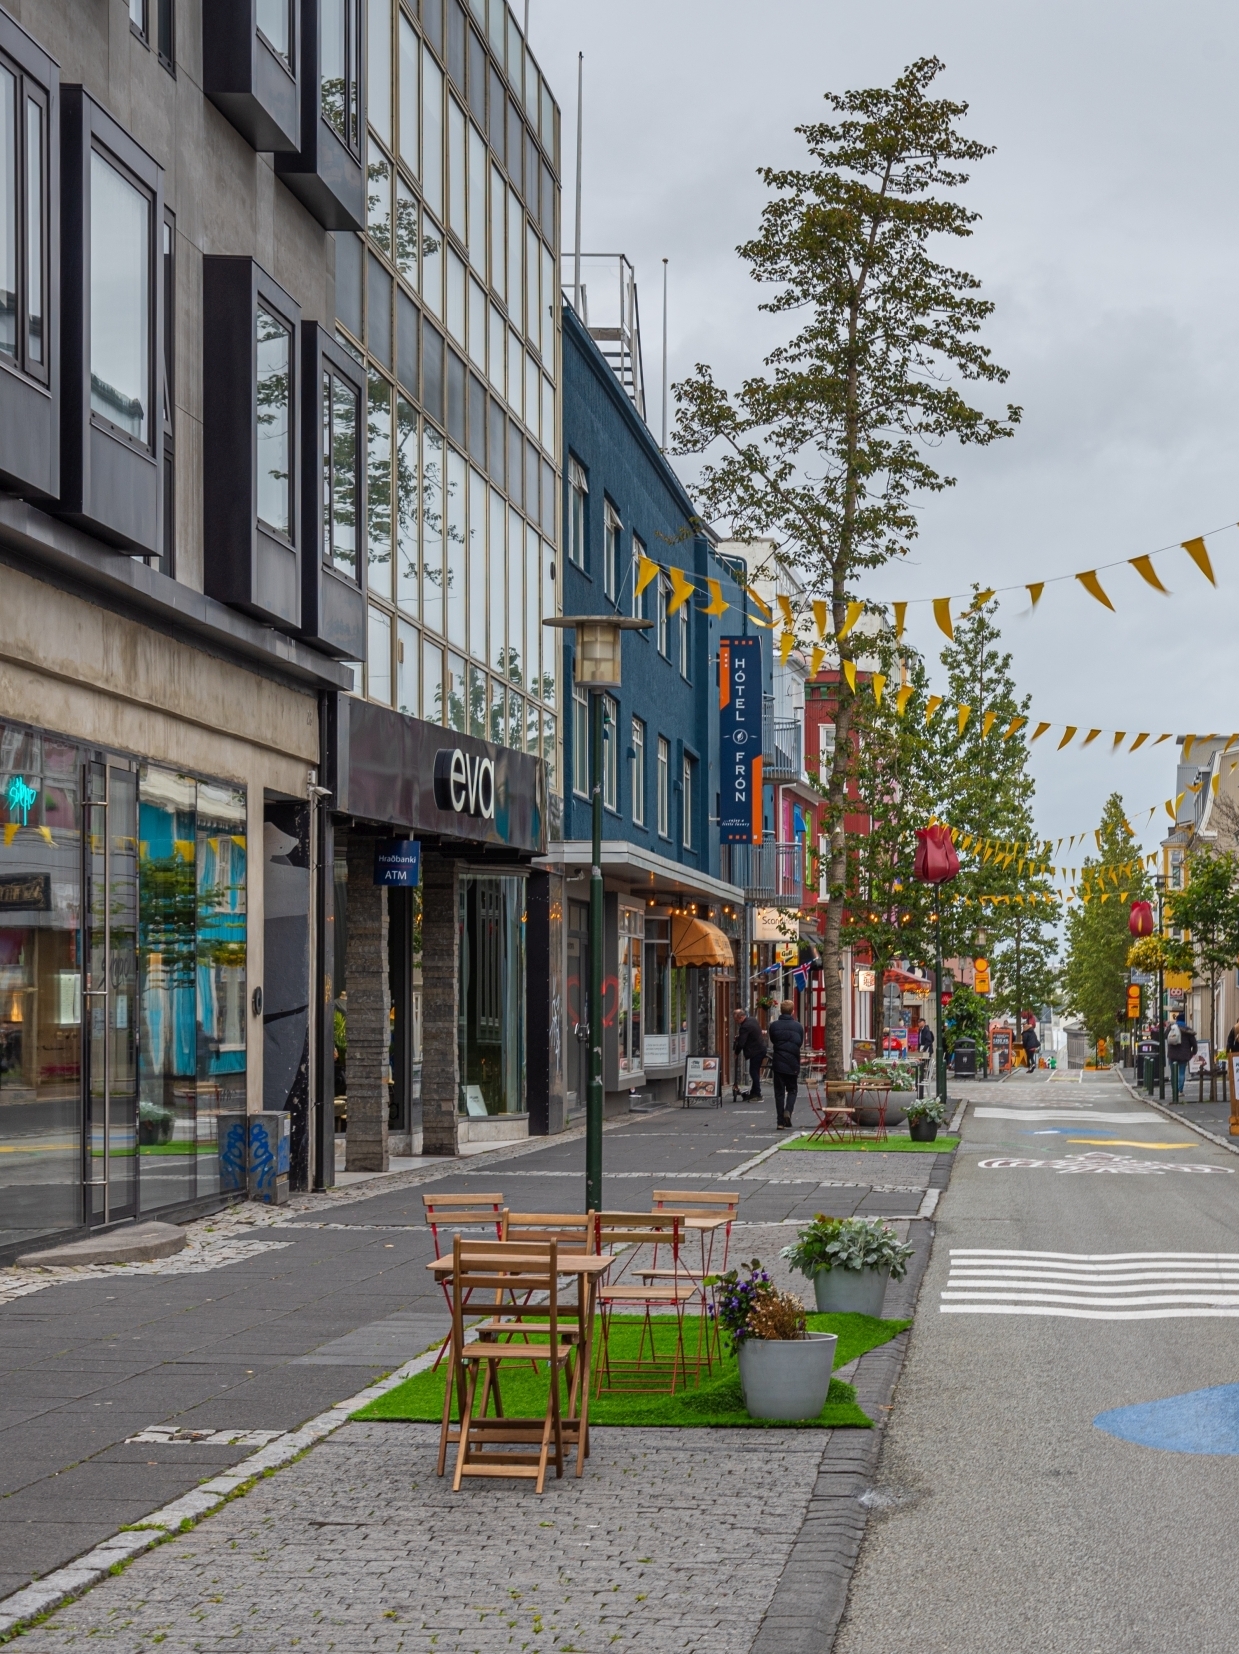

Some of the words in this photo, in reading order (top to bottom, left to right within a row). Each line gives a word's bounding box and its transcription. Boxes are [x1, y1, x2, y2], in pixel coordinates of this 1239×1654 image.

[735, 657, 746, 722] HÓTEL
[450, 748, 495, 819] eva
[735, 752, 746, 802] FRÓN
[378, 854, 417, 864] Hraðbanki
[384, 870, 407, 881] ATM
